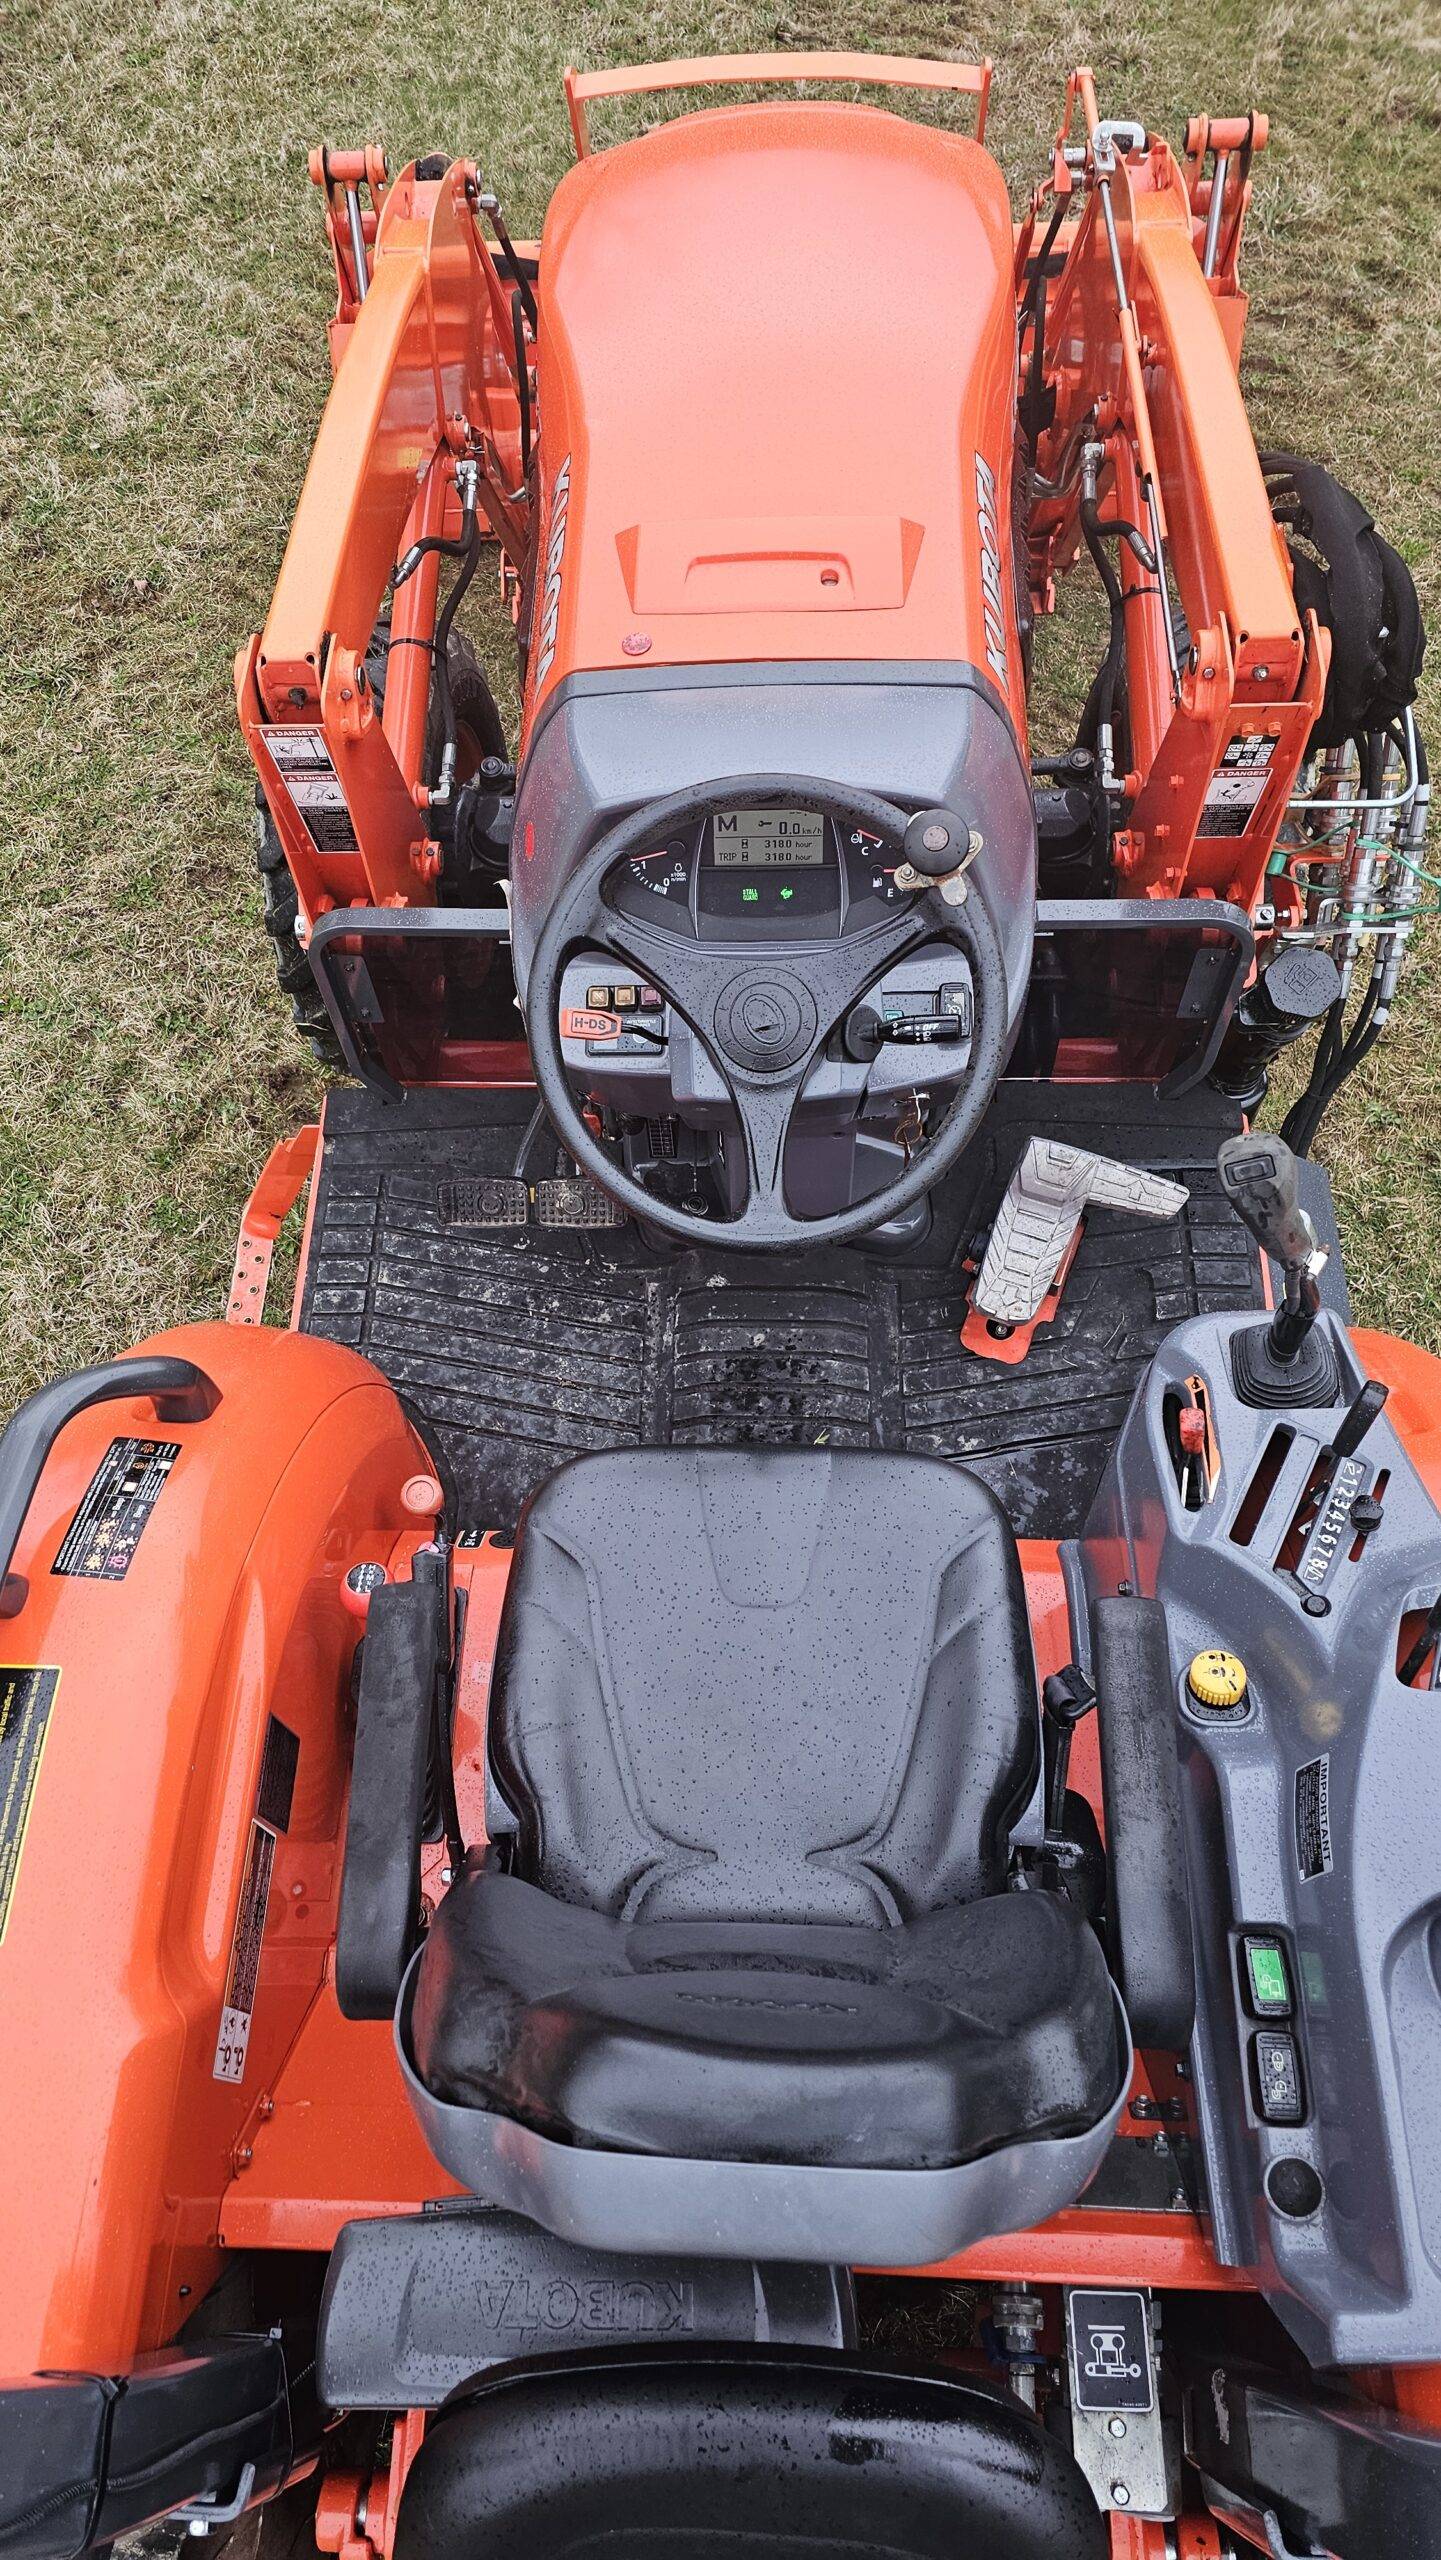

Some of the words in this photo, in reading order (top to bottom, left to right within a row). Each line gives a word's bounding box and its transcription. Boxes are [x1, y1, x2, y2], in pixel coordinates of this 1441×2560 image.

[975, 450, 1010, 698] KUBOTA
[718, 815, 737, 832] M
[779, 821, 800, 834] 0.0
[802, 826, 822, 834] km/h
[719, 852, 737, 861] TRIP
[796, 853, 812, 861] hour
[861, 847, 869, 856] C
[641, 861, 646, 870] 1
[663, 878, 670, 887] 0
[887, 888, 894, 898] E
[574, 1017, 606, 1031] H-DS
[922, 1023, 940, 1031] OFF
[1342, 1477, 1358, 1486] 1
[1338, 1486, 1355, 1498] 2
[1334, 1498, 1351, 1510] 3
[1330, 1510, 1346, 1522] 4
[1325, 1521, 1342, 1534] 5
[1320, 1534, 1338, 1545] 6
[1316, 1546, 1334, 1558] 7
[1311, 1558, 1329, 1570] 8
[1320, 1763, 1331, 1861] IMPORTANT
[474, 2279, 696, 2333] KUBOTA
